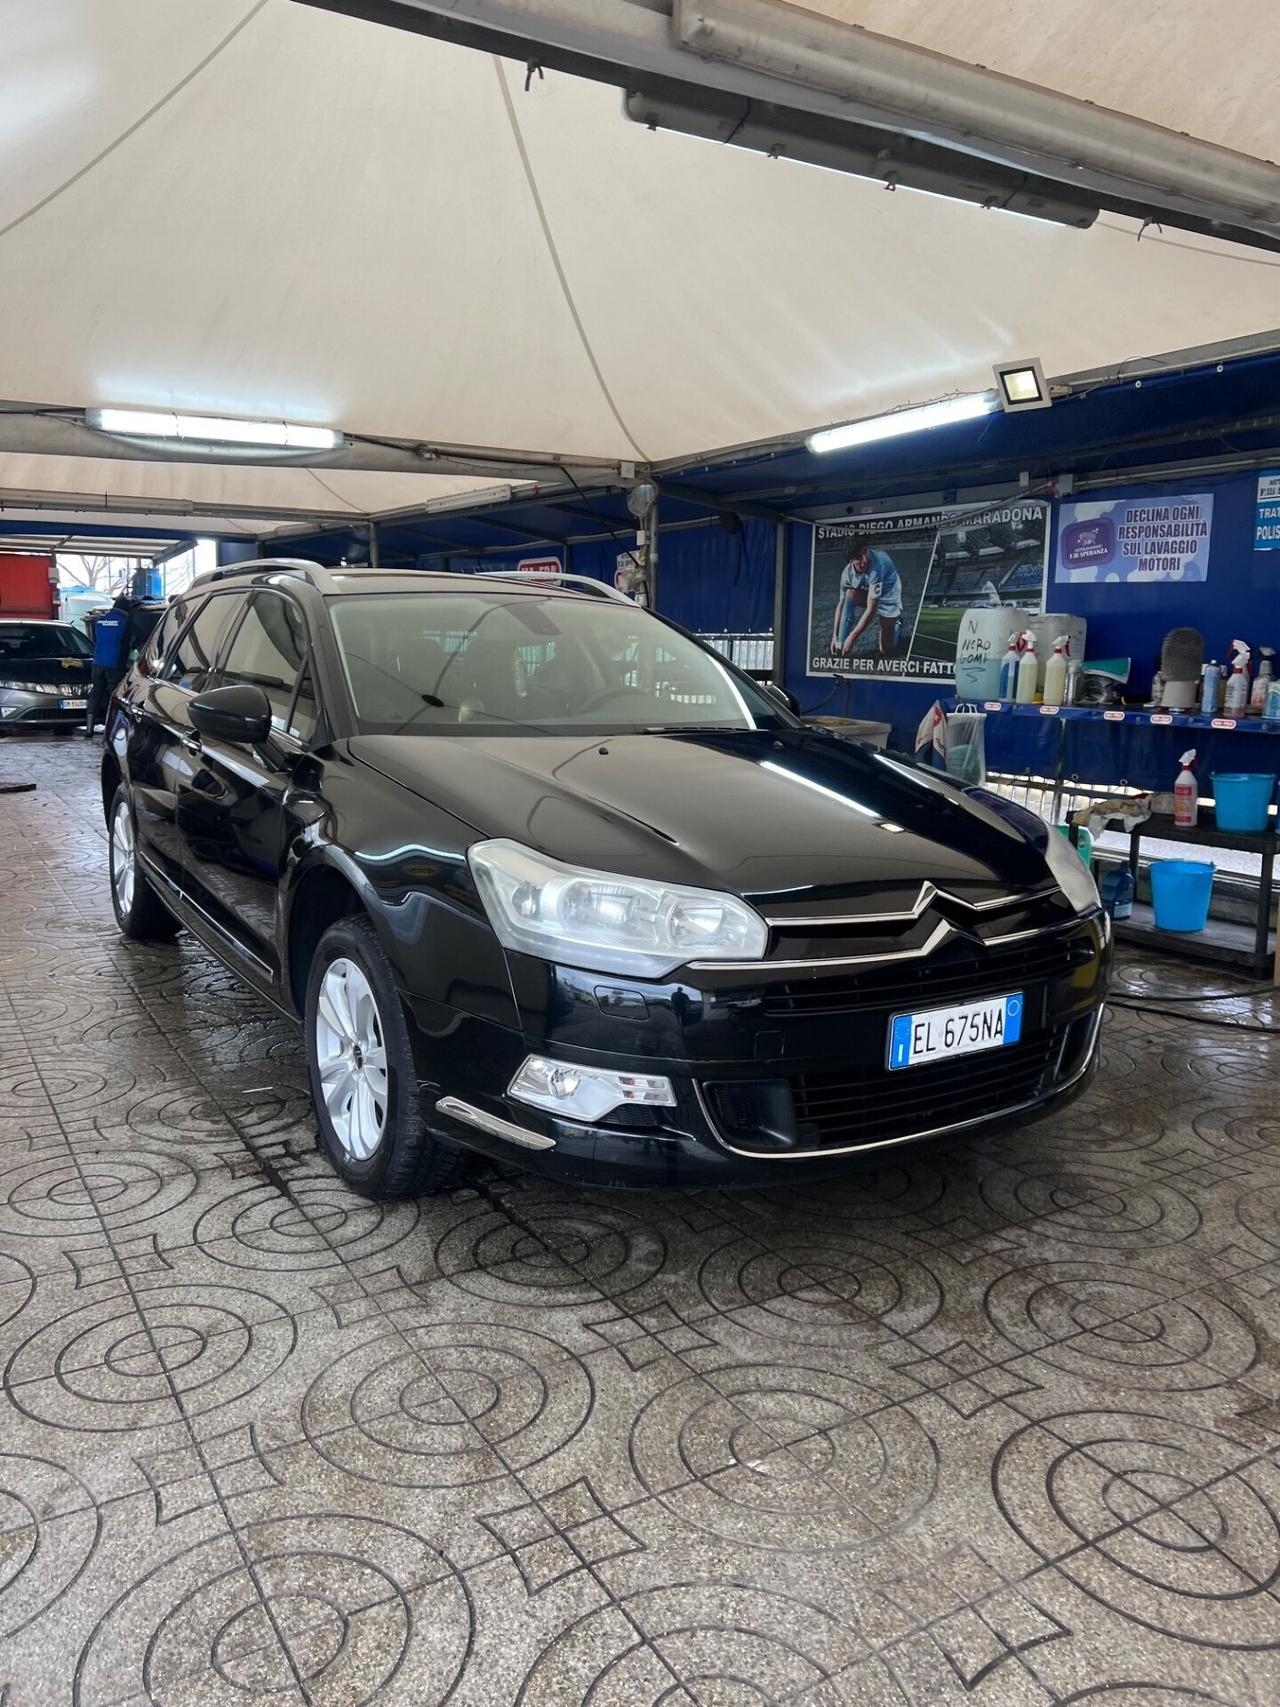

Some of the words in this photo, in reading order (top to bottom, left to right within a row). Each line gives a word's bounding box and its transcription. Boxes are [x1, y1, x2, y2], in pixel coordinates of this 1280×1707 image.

[859, 520, 893, 535] DIEGO
[897, 512, 958, 532] ARMANDO
[962, 506, 1043, 527] MARADONA
[1126, 508, 1169, 523] DECLINA
[1172, 506, 1200, 520] OGNI
[1118, 520, 1207, 539] RESPONSABILITÀ
[1123, 542, 1141, 555] SUL
[1144, 540, 1197, 555] LAVAGGIO
[1138, 557, 1180, 571] MOTORI
[962, 638, 991, 651] NERO
[812, 657, 849, 669] GRAZIE
[853, 658, 874, 671] PER
[877, 659, 919, 673] AVERCI
[913, 1022, 936, 1055] EL
[944, 1009, 1003, 1048] 675NA
